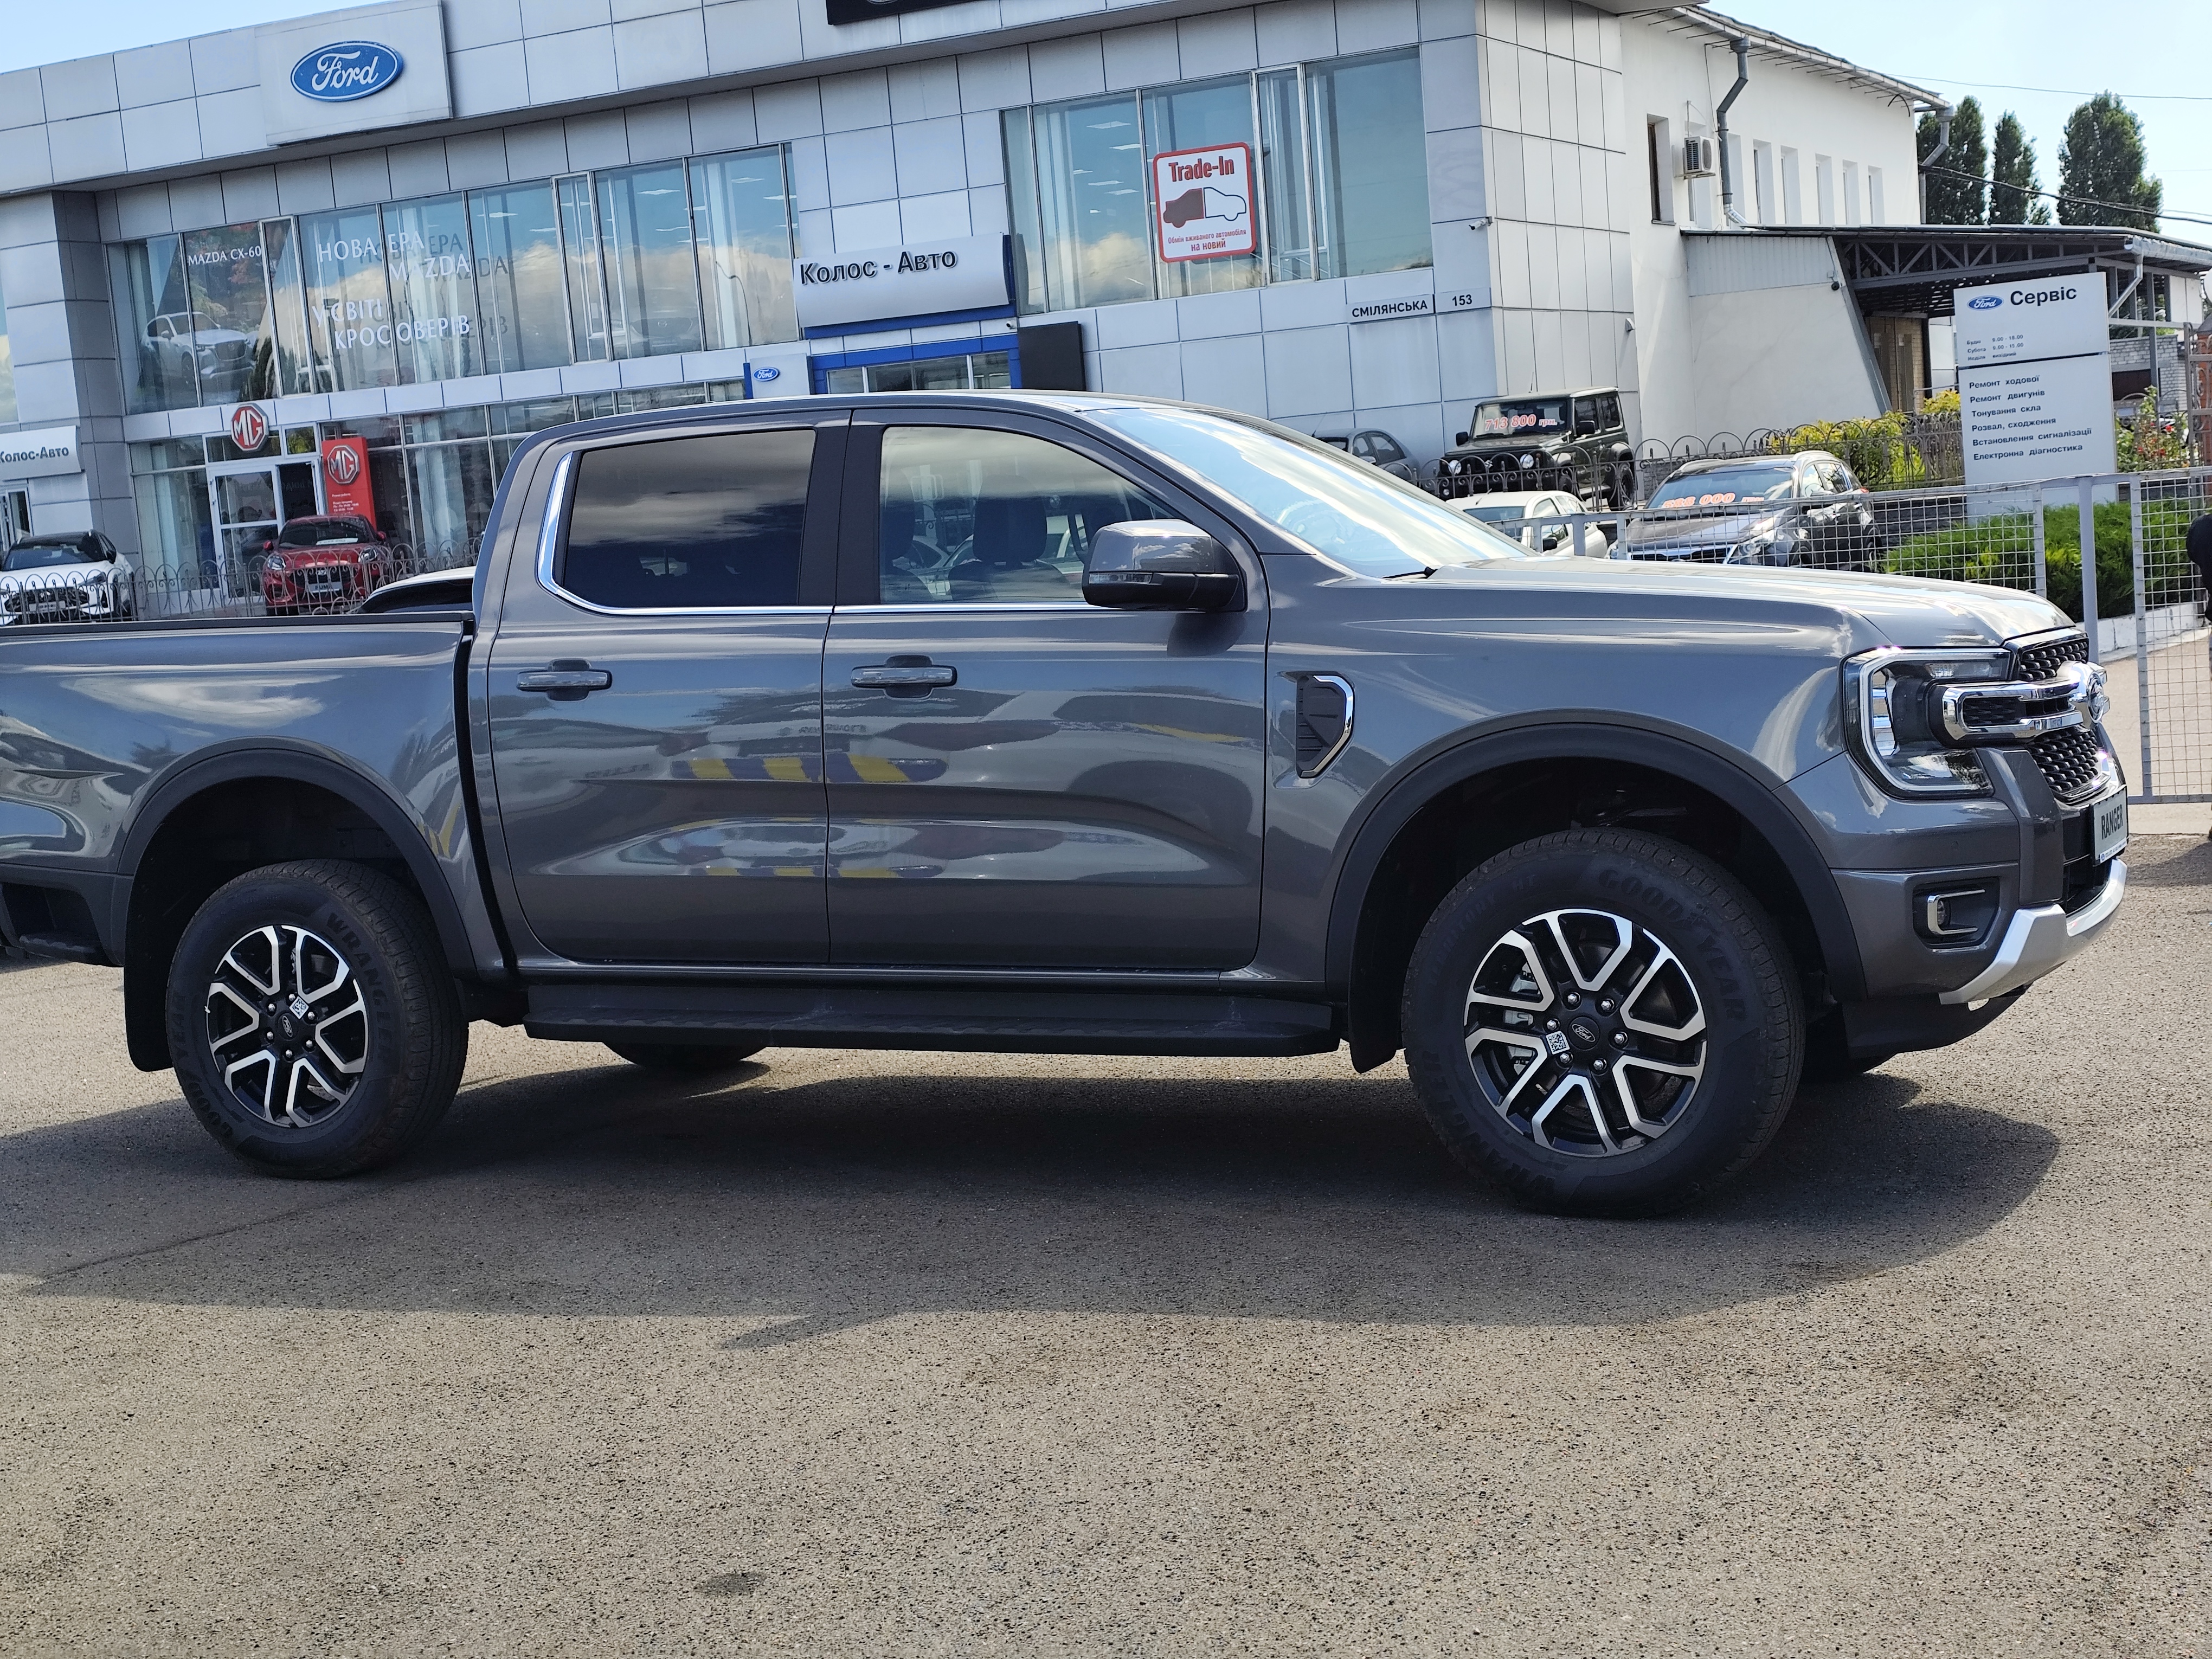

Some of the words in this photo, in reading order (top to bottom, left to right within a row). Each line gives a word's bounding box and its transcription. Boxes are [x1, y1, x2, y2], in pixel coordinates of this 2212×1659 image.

[312, 51, 378, 91] Ford
[1168, 156, 1234, 182] Trade-In
[318, 237, 377, 262] НОВА
[388, 230, 425, 253] ЕРА
[1168, 236, 1184, 244] Обмін
[1185, 233, 1214, 242] вживаного
[1216, 228, 1246, 239] автомобіля
[1203, 239, 1226, 250] новий
[188, 252, 228, 266] MAZDA
[230, 246, 261, 260] CX-60
[388, 253, 471, 283] MAZDA
[800, 261, 877, 285] Колос
[897, 250, 957, 273] Авто
[1352, 300, 1428, 318] СМІЛЯНСЬКА
[1452, 294, 1473, 306] 153
[1973, 298, 1997, 308] Ford
[2010, 286, 2077, 306] Сервіс
[331, 299, 382, 323] СВІТІ
[1969, 380, 2001, 389] Ремонт
[2005, 375, 2040, 385] ходової
[1970, 395, 2001, 403] Ремонт
[2007, 389, 2046, 401] двигунів
[1971, 408, 2016, 417] Тонування
[233, 409, 262, 446] MG
[1485, 416, 1508, 432] 713
[1510, 414, 1536, 427] 800
[1539, 419, 1558, 427] грн.
[1972, 423, 2005, 432] Розвал,
[2008, 417, 2056, 429] сходження
[1972, 434, 2034, 446] Встановлення
[2038, 427, 2092, 440] сигналізації
[1973, 449, 2024, 460] Електронна
[2029, 444, 2083, 456] діагностика
[331, 450, 355, 480] MG
[1699, 492, 1735, 505] 000
[2101, 803, 2124, 840] RANGER
[1598, 869, 1747, 1023] GOODYEAR
[325, 912, 394, 1062] WRANGLER
